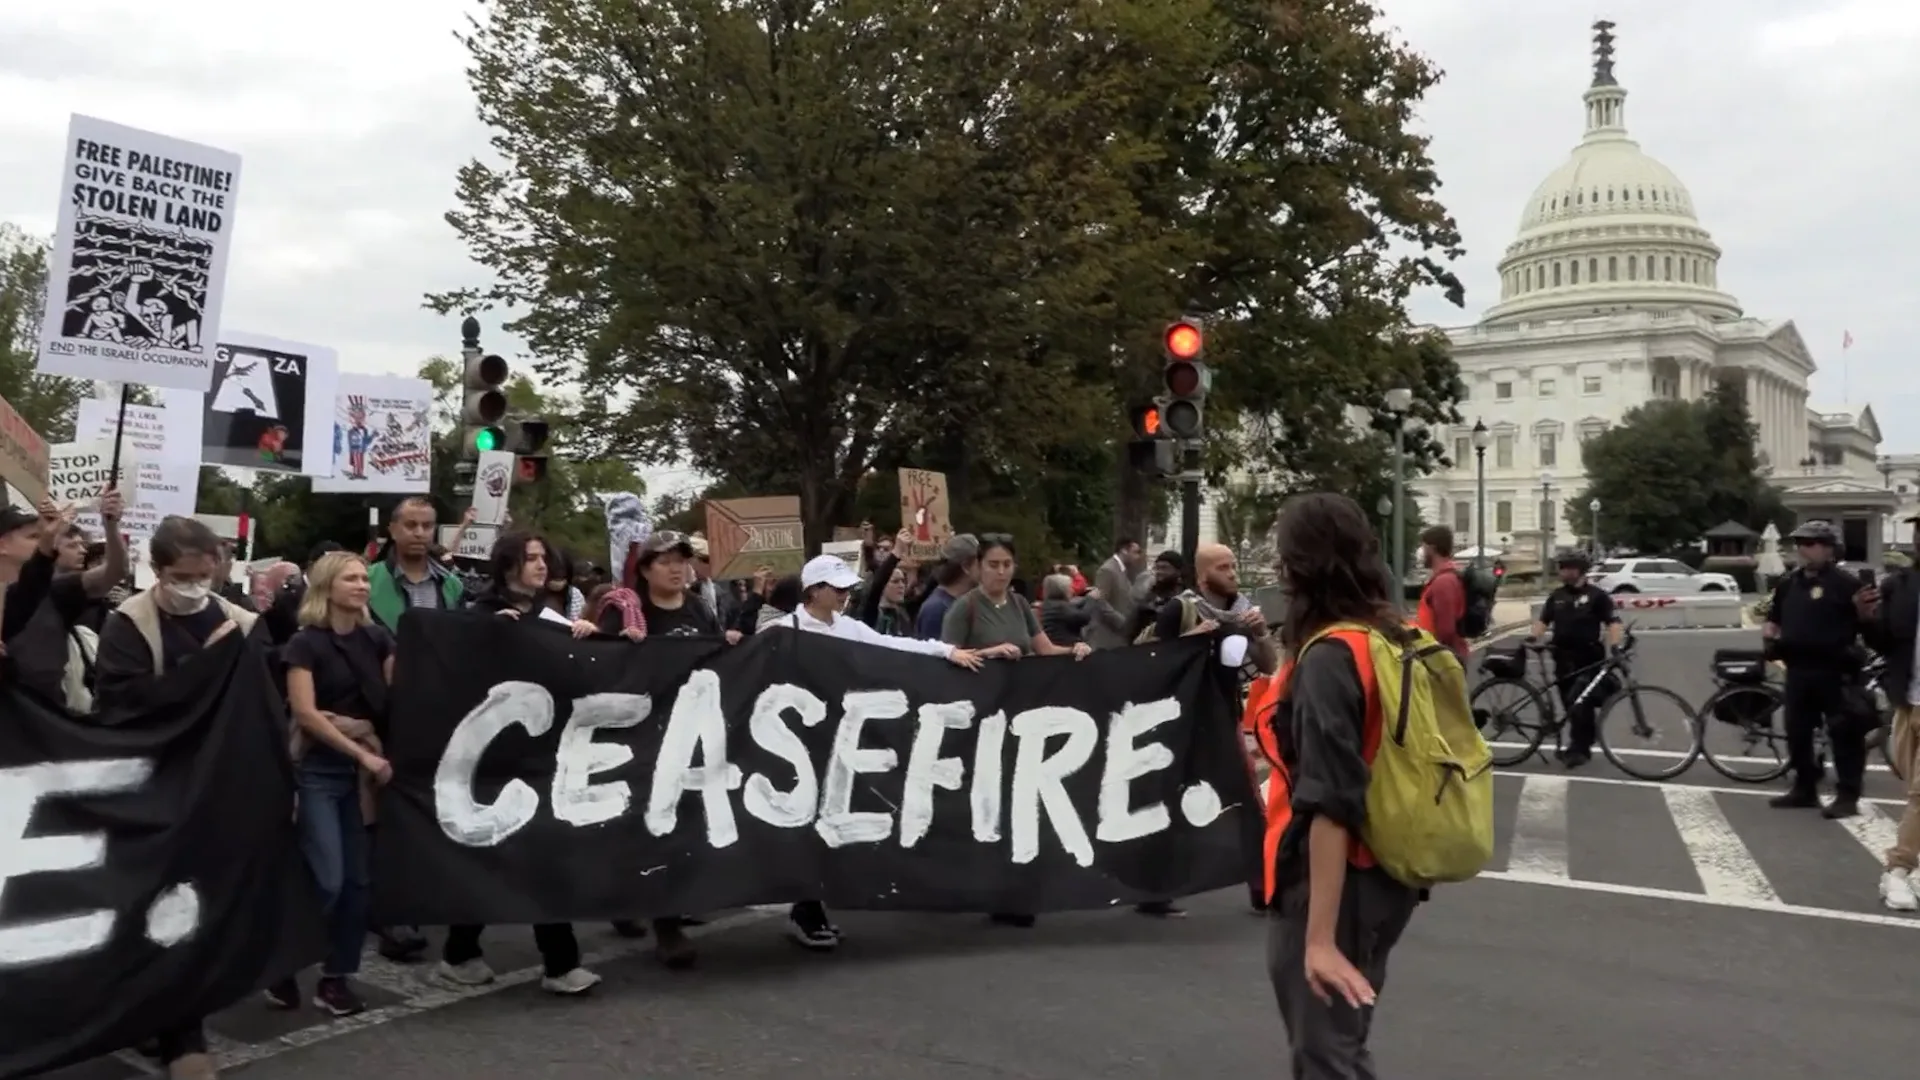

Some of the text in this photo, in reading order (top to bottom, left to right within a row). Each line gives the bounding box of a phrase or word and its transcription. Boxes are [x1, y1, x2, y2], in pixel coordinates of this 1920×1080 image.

[76, 138, 232, 192] FREE PALESTINE!
[75, 164, 225, 209] GIVE BACK THE
[72, 183, 222, 233] STOLEN LAND
[50, 341, 208, 368] END THE ISRAELI OCCUPATION
[52, 468, 124, 487] NOCIDE
[65, 485, 102, 500] GAZ
[76, 518, 97, 526] AKE
[433, 669, 1222, 867] CEASEFIRE.
